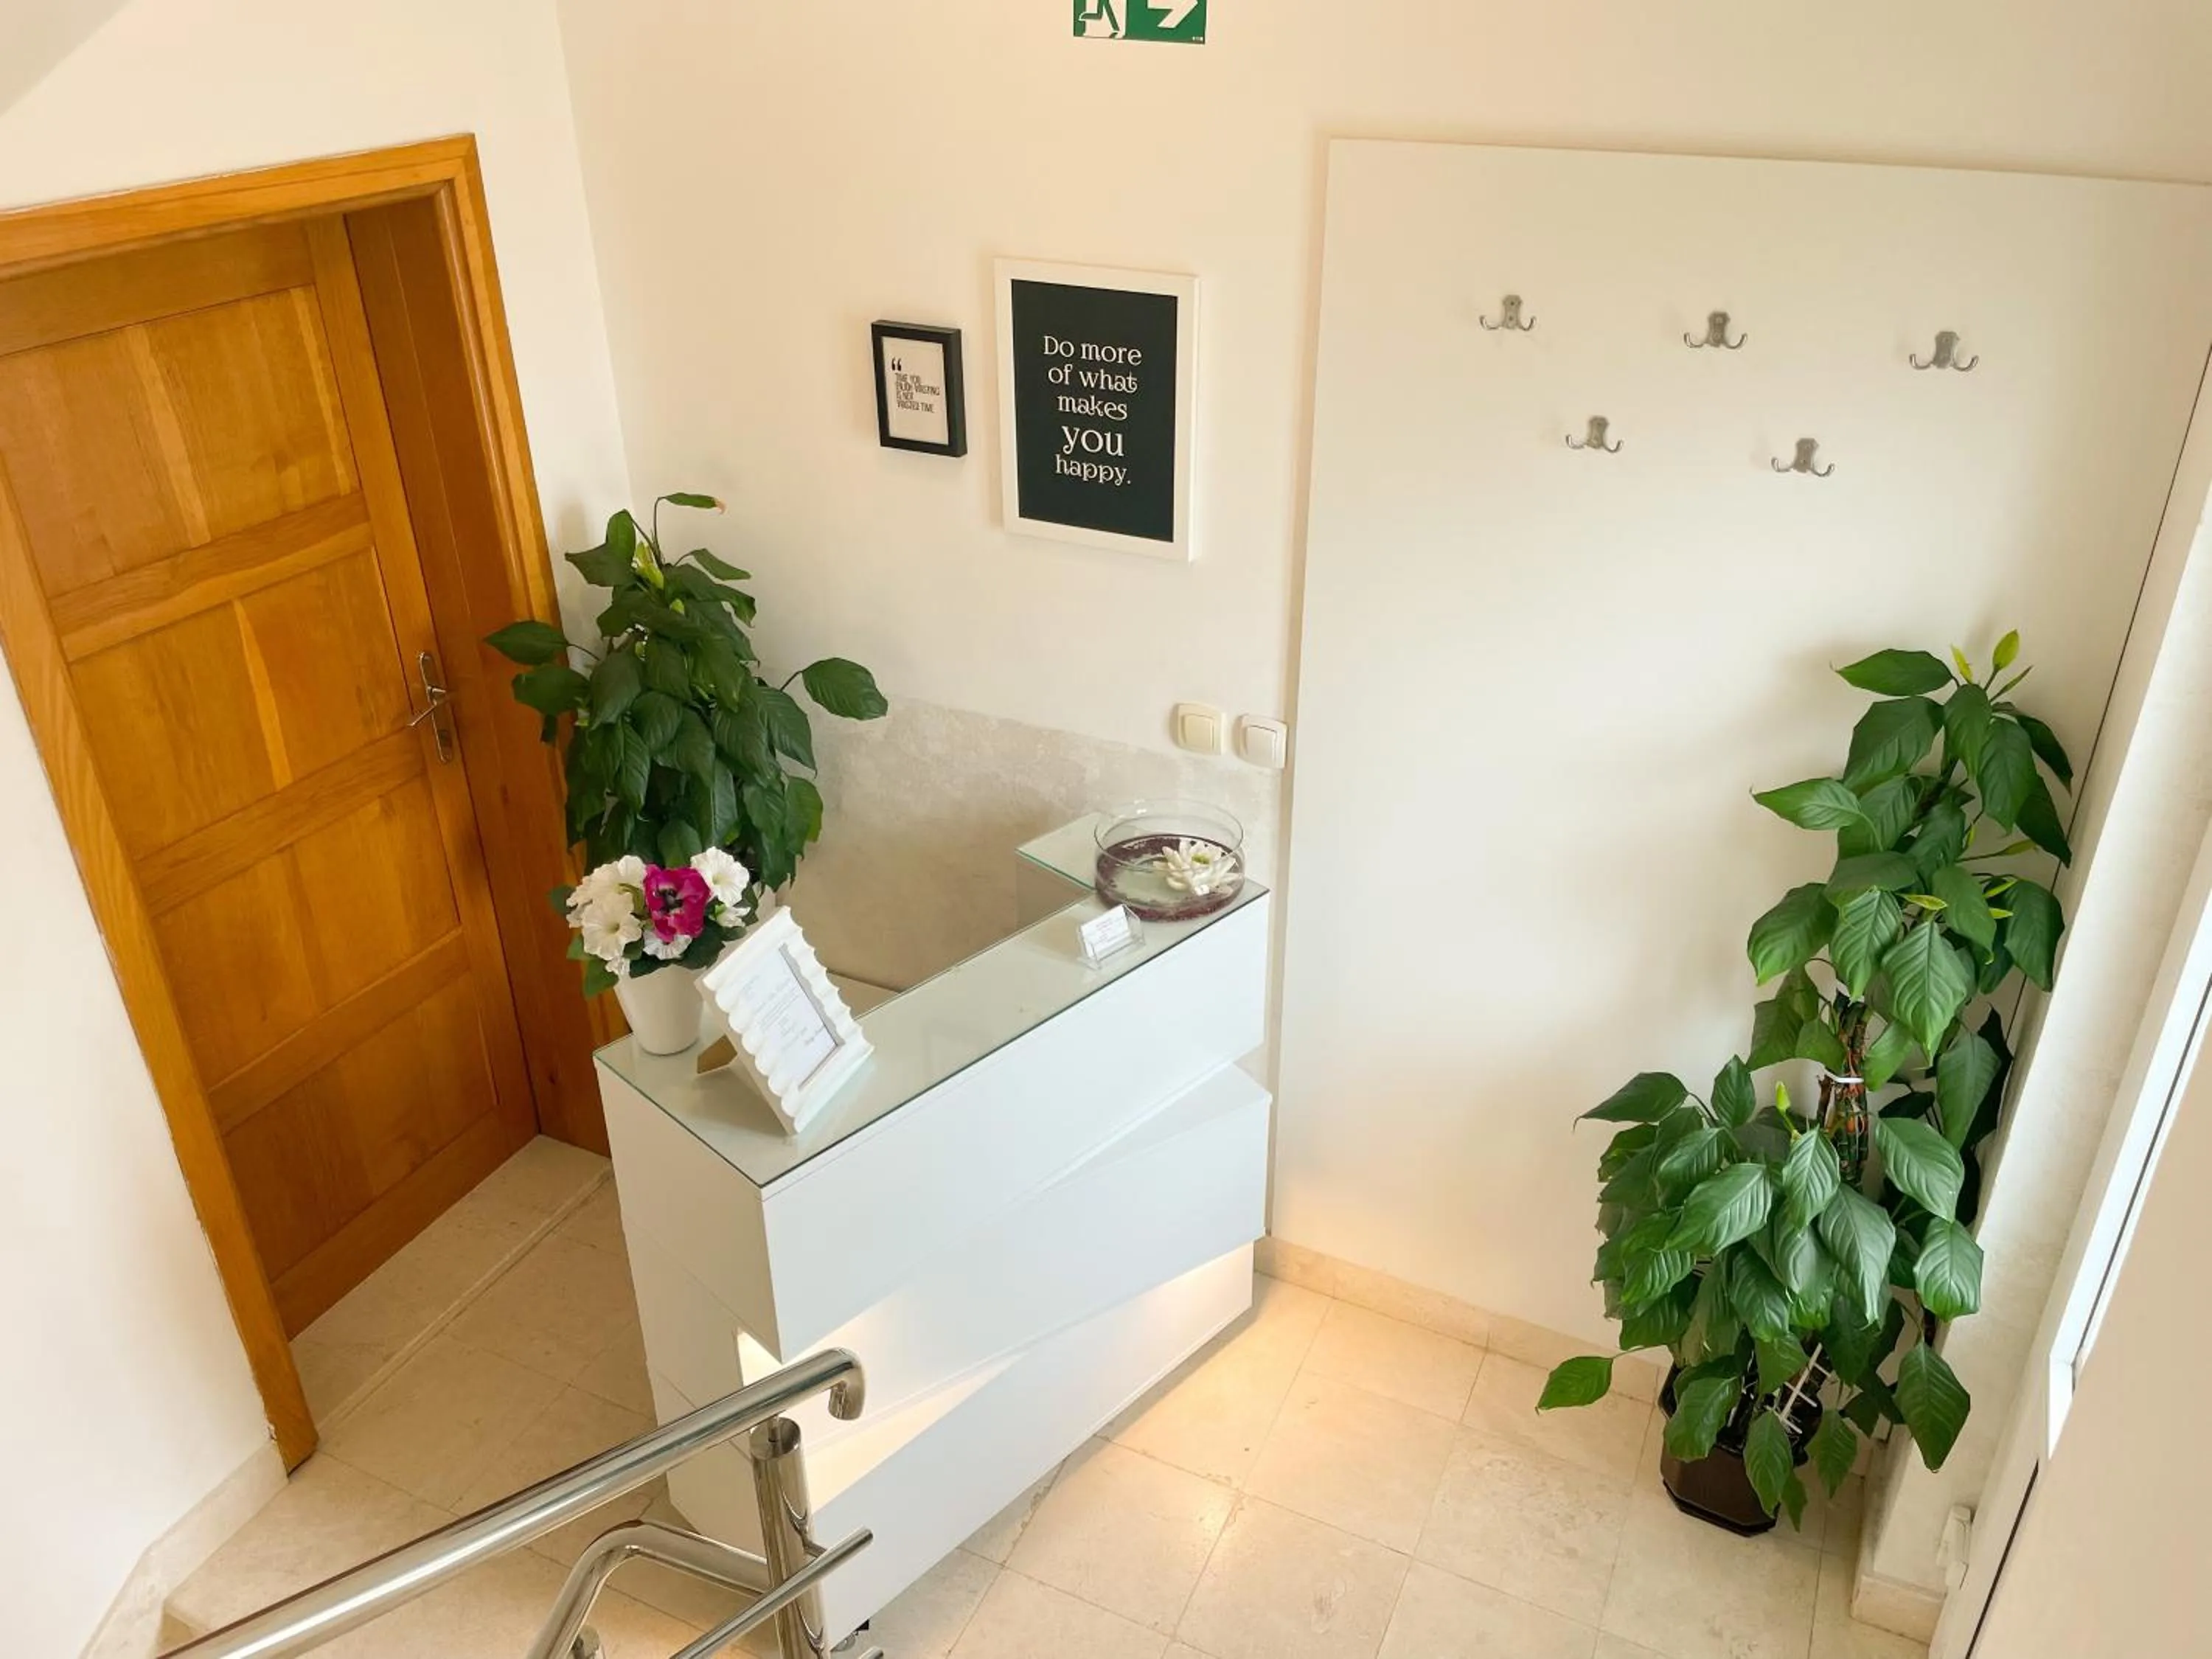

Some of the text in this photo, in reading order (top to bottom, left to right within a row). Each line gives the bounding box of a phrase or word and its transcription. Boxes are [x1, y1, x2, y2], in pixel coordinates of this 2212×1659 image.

[1043, 335, 1142, 366] Do more
[1048, 364, 1138, 393] of what
[1057, 394, 1127, 420] makes
[1061, 425, 1124, 456] you
[1055, 453, 1131, 486] happy.
